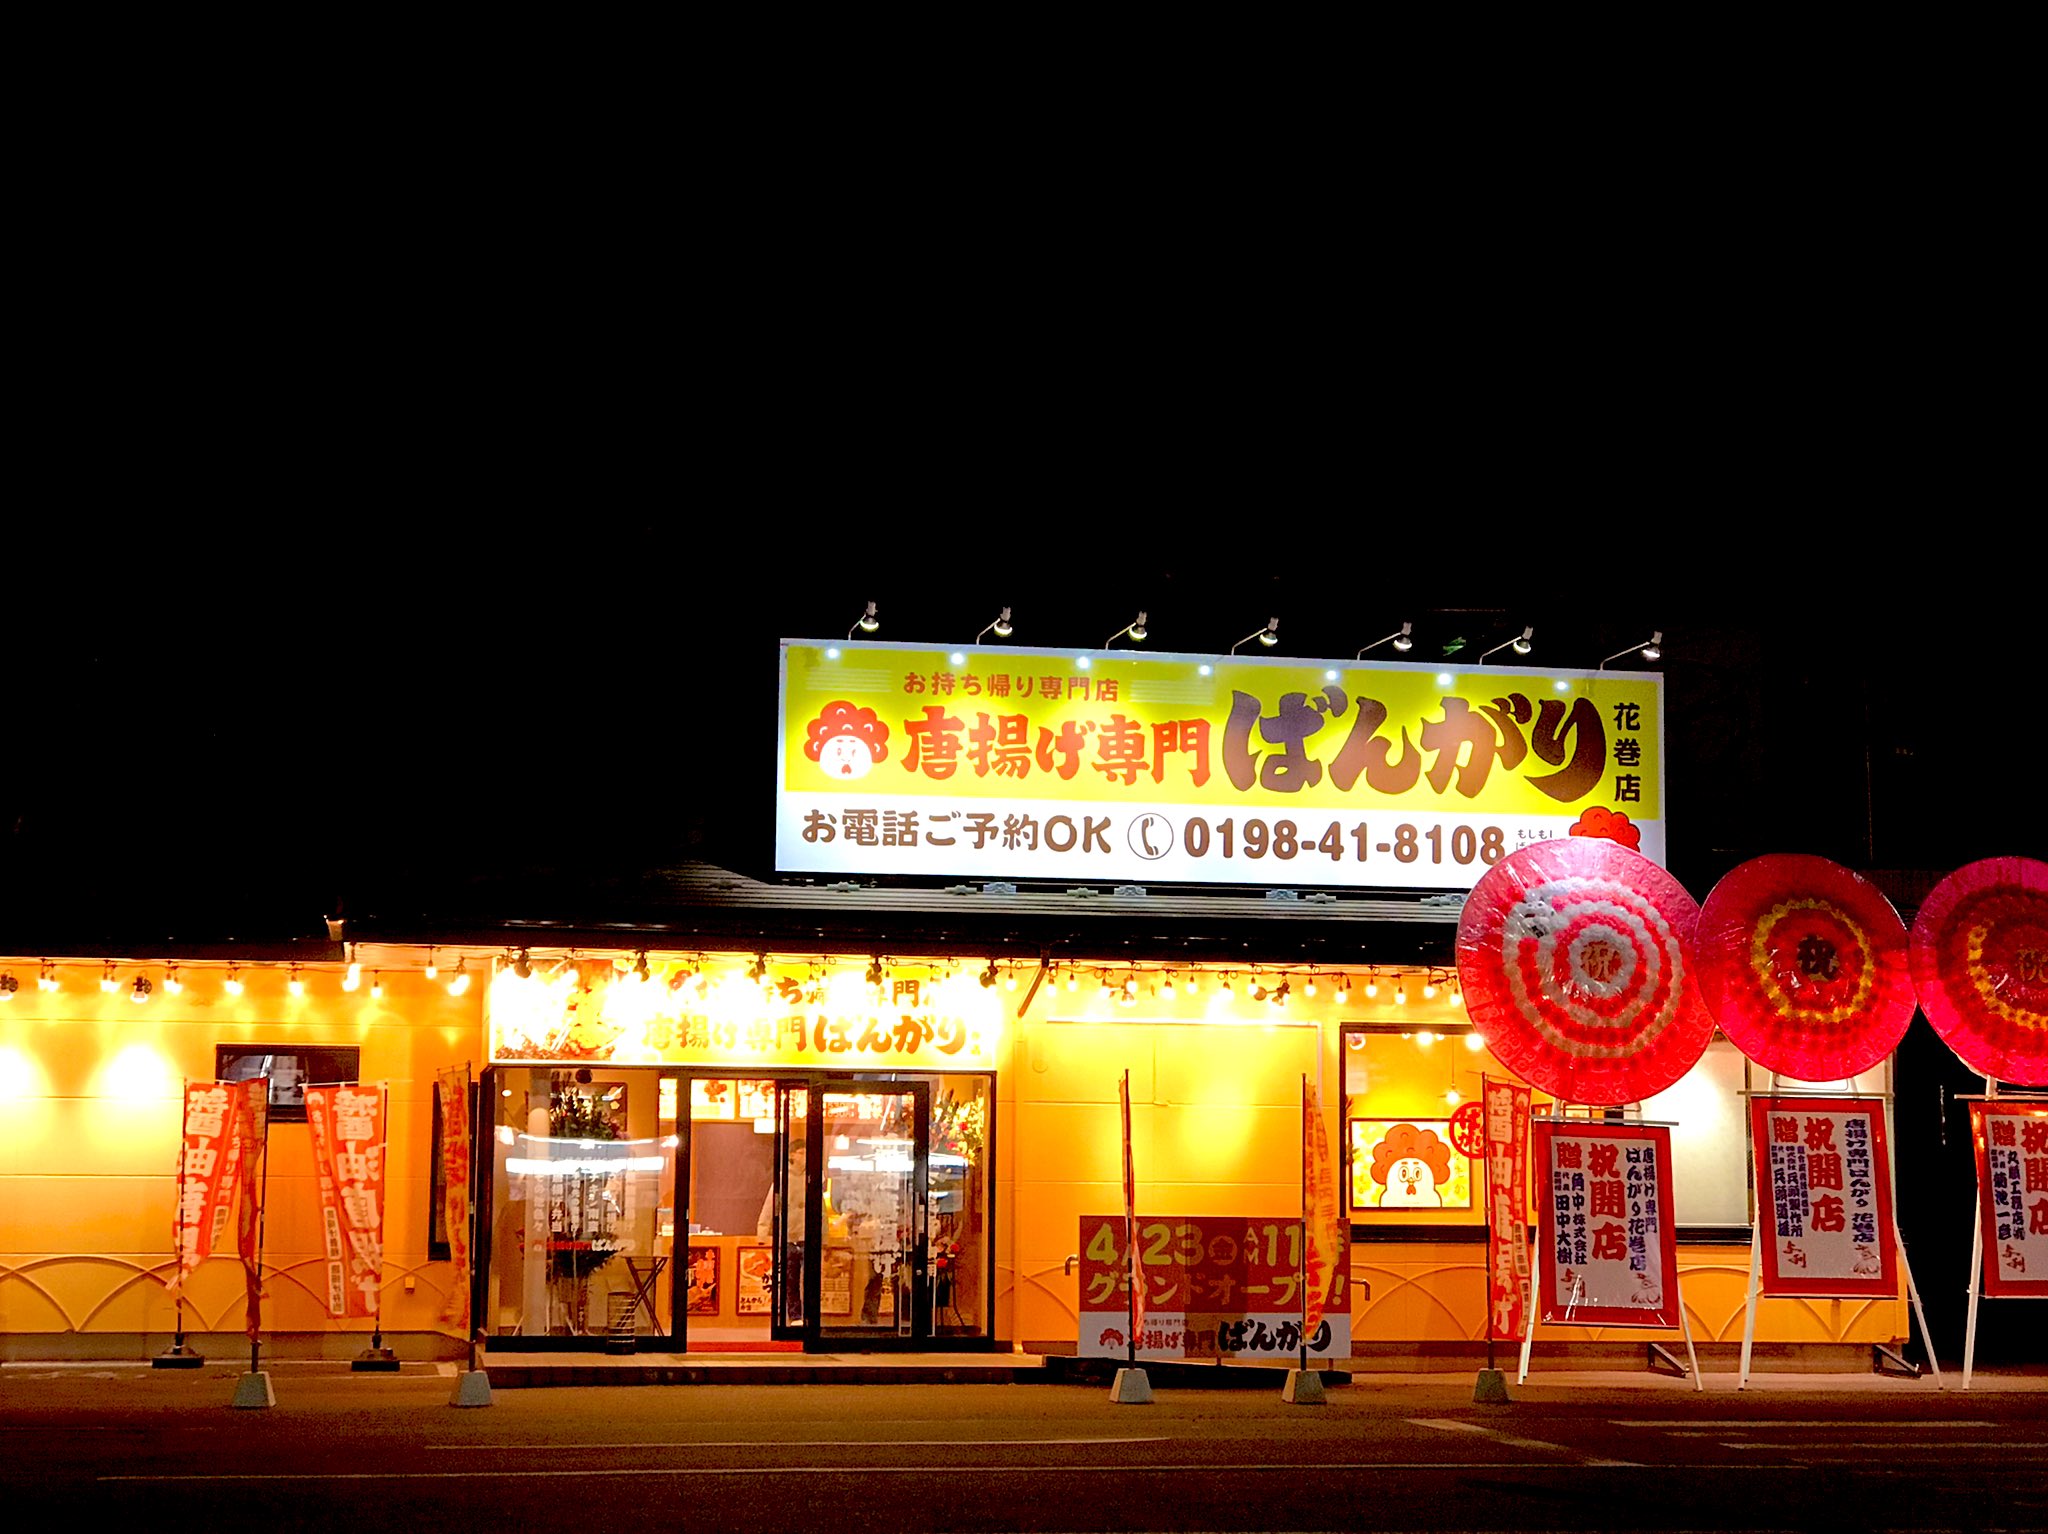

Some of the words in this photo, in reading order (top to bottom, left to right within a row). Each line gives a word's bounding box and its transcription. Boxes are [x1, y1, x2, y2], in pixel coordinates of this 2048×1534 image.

[903, 671, 1119, 703] お持ち帰り専門店
[900, 705, 1212, 788] 唐揚げ専門
[1222, 685, 1607, 803] ばんがり
[1612, 701, 1642, 803] 花巻店
[802, 808, 1112, 855] お電話ご予約OK
[1184, 816, 1506, 866] 0198-41-8108
[1555, 1141, 1582, 1170] 贈
[1772, 1116, 1799, 1144] 贈
[1990, 1119, 2016, 1147] 贈
[1587, 1142, 1628, 1262] 祝開店
[1642, 1147, 1658, 1234] 唐揚げ専門
[1804, 1116, 1846, 1233] 祝開店
[1625, 1147, 1646, 1272] ばんがり花巻店
[1243, 1227, 1259, 1265] AM
[1086, 1271, 1345, 1305] グンドオープ!
